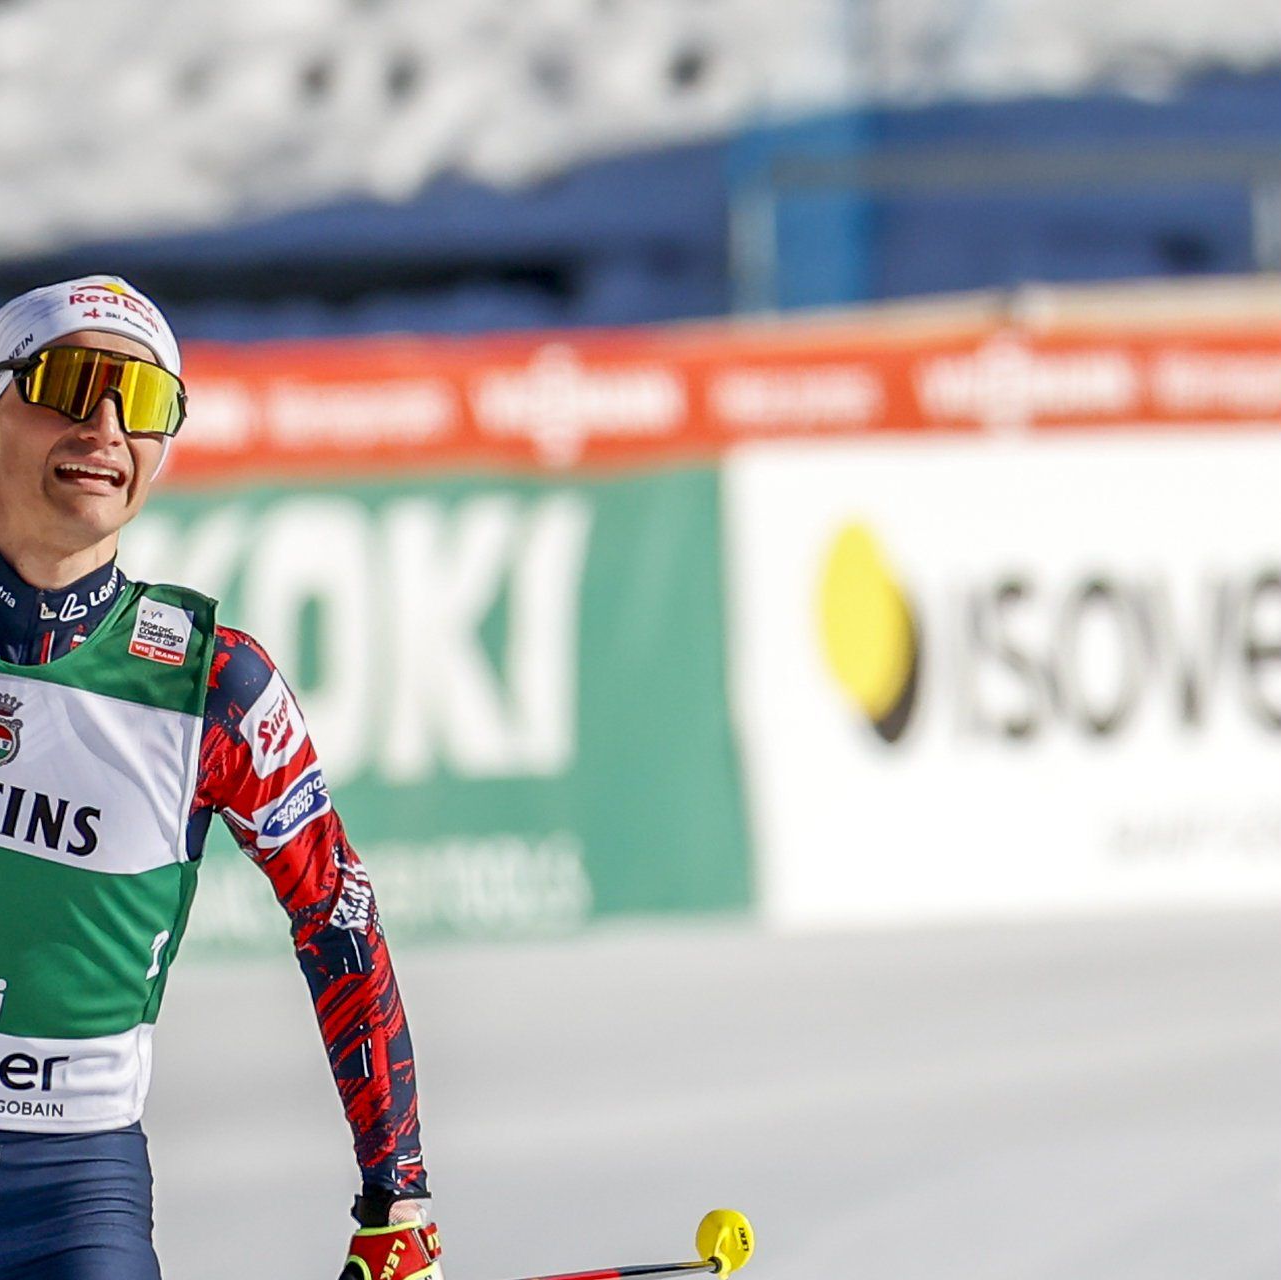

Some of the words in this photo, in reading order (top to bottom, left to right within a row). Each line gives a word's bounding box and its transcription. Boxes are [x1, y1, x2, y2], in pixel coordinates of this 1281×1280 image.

[69, 293, 119, 306] Red
[140, 620, 174, 635] NORDIC
[139, 627, 184, 643] COMBINED
[163, 639, 177, 648] CUP
